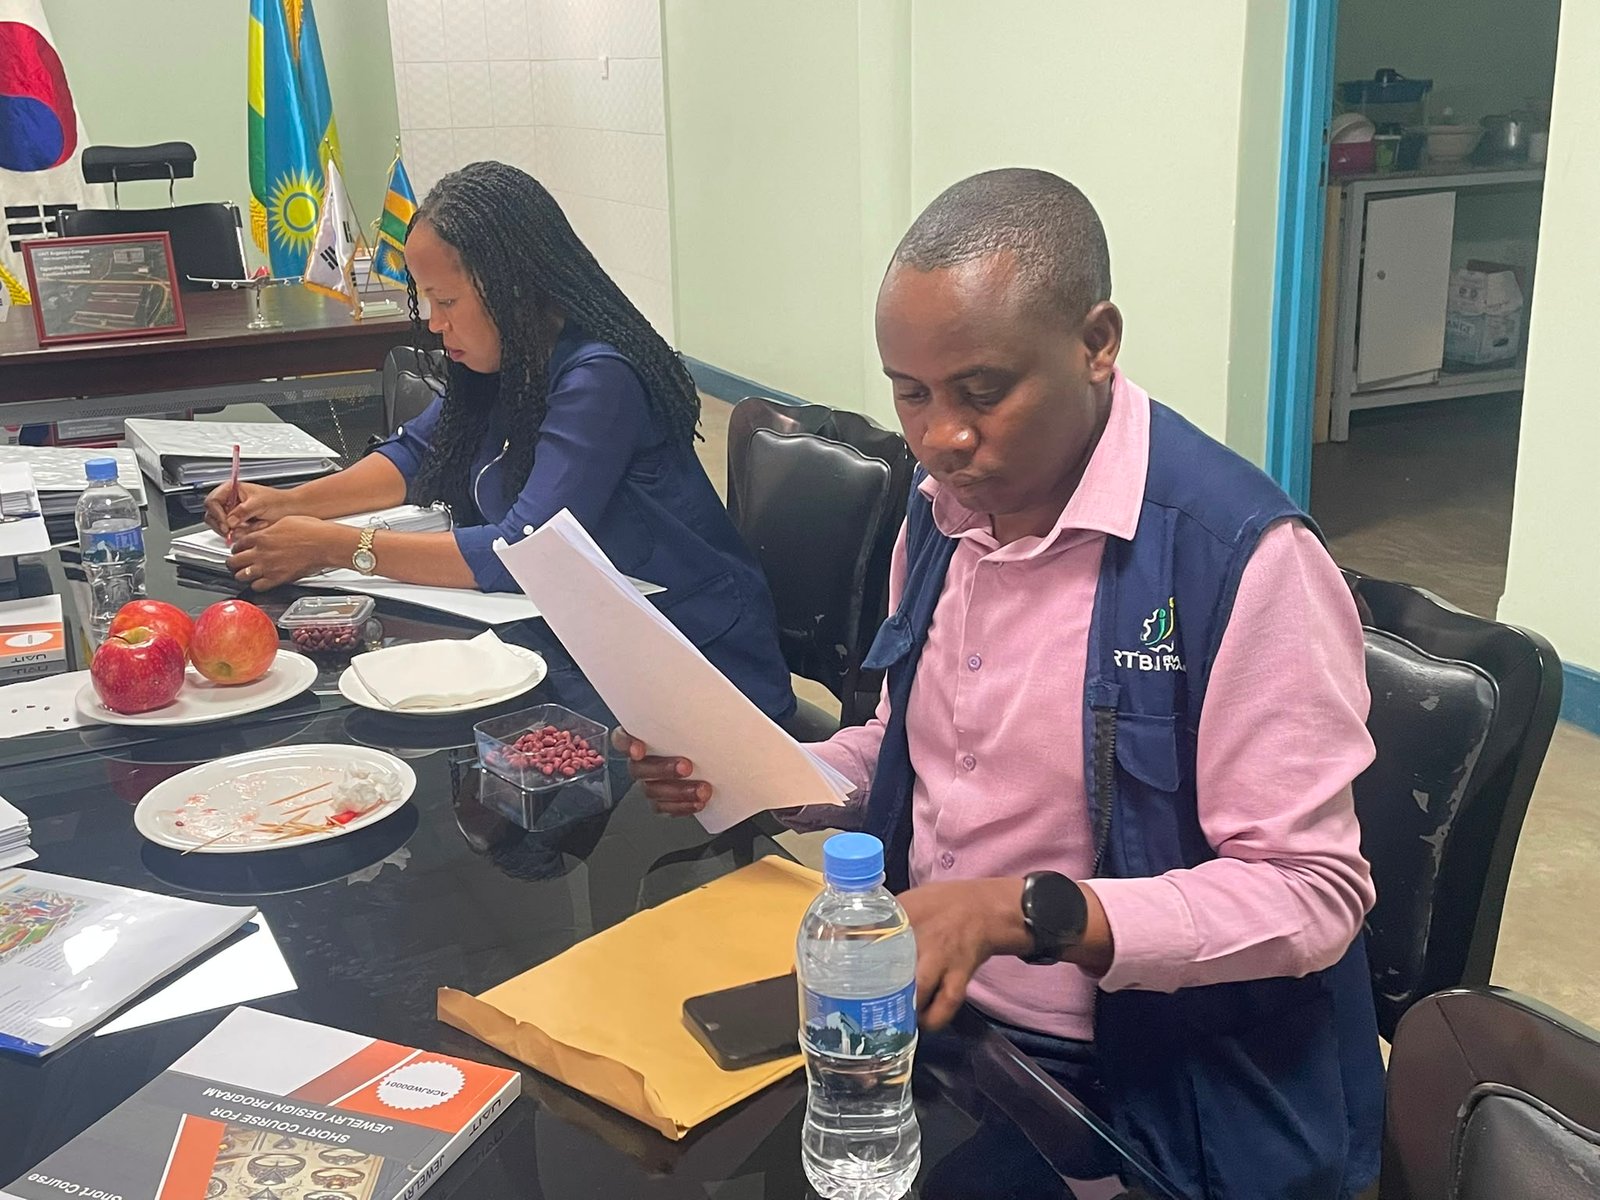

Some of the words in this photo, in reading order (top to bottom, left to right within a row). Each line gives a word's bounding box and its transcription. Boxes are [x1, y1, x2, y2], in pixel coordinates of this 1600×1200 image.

[203, 1087, 271, 1110] PROGRAM
[210, 1106, 242, 1119] FOR
[272, 1103, 324, 1120] DESIGN
[240, 1113, 300, 1133] COURSE
[325, 1113, 394, 1134] JEWELRY
[298, 1128, 351, 1144] SHORT
[27, 1173, 80, 1194] Course
